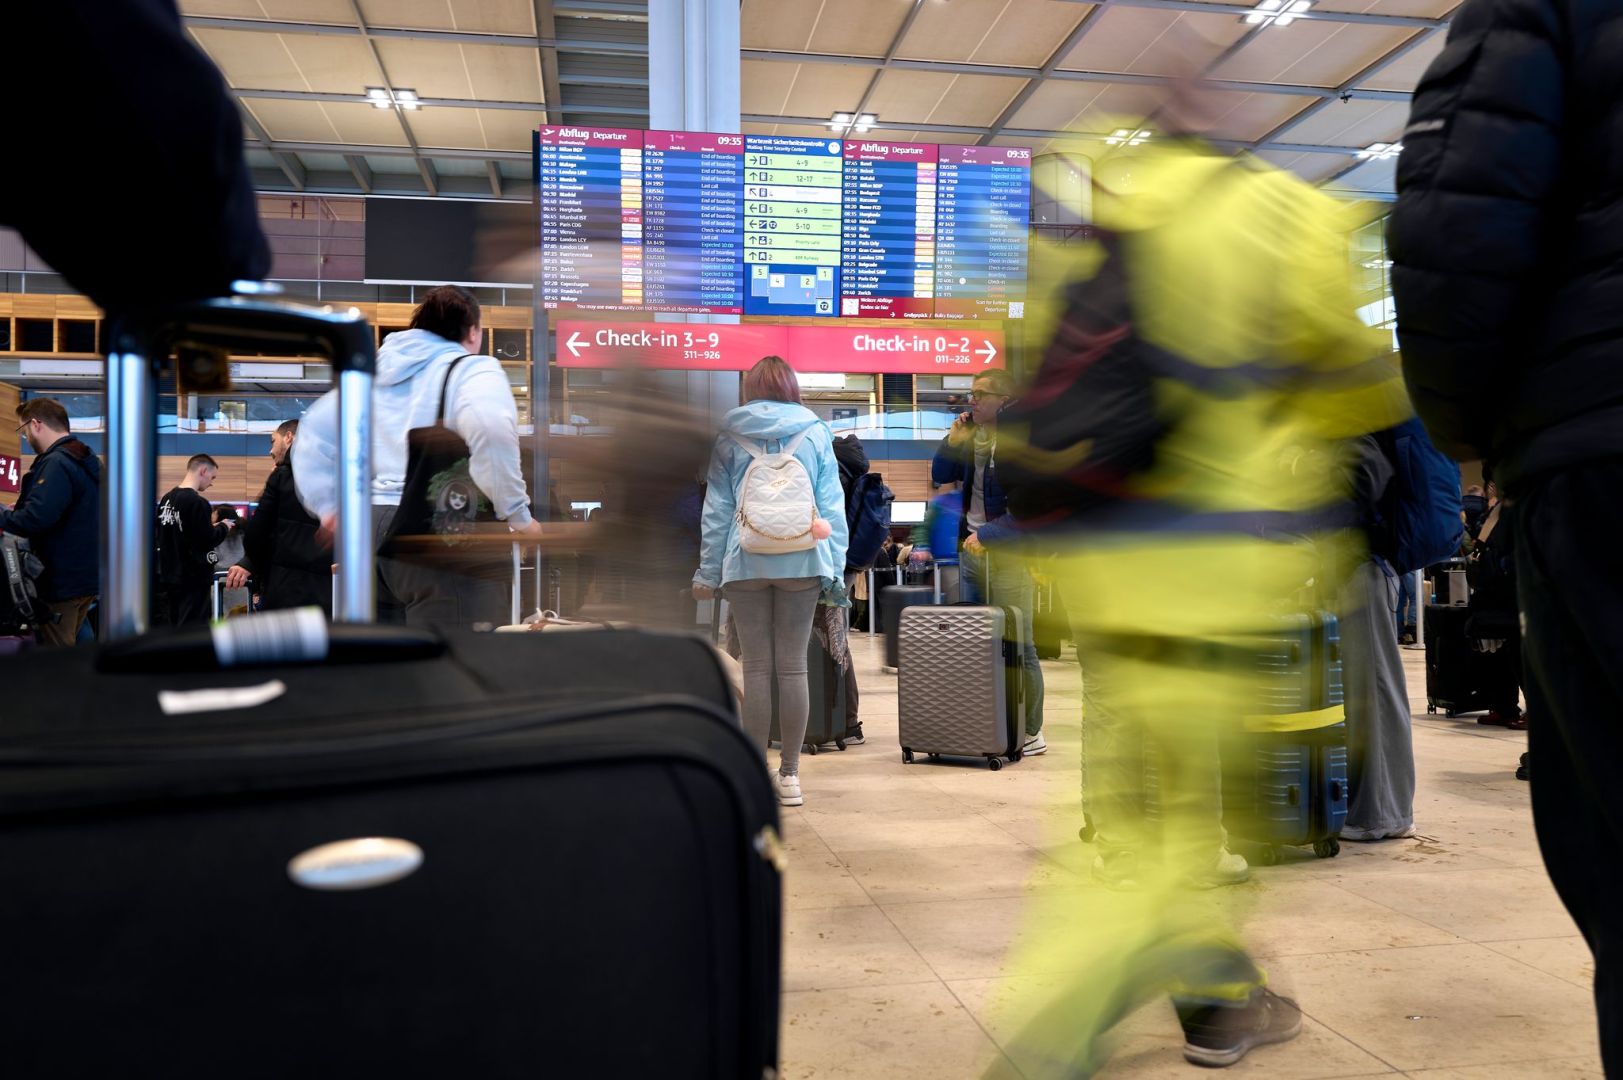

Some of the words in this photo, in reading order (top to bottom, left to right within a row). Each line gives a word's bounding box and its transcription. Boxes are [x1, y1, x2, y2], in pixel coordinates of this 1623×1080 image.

[559, 128, 589, 140] Abflug
[593, 132, 627, 140] Departure
[718, 137, 742, 145] 09:35
[860, 144, 888, 154] Abflug
[1007, 150, 1029, 159] 09:35
[595, 329, 678, 348] Check-in
[853, 334, 930, 352] Check-in
[8, 460, 18, 485] 4
